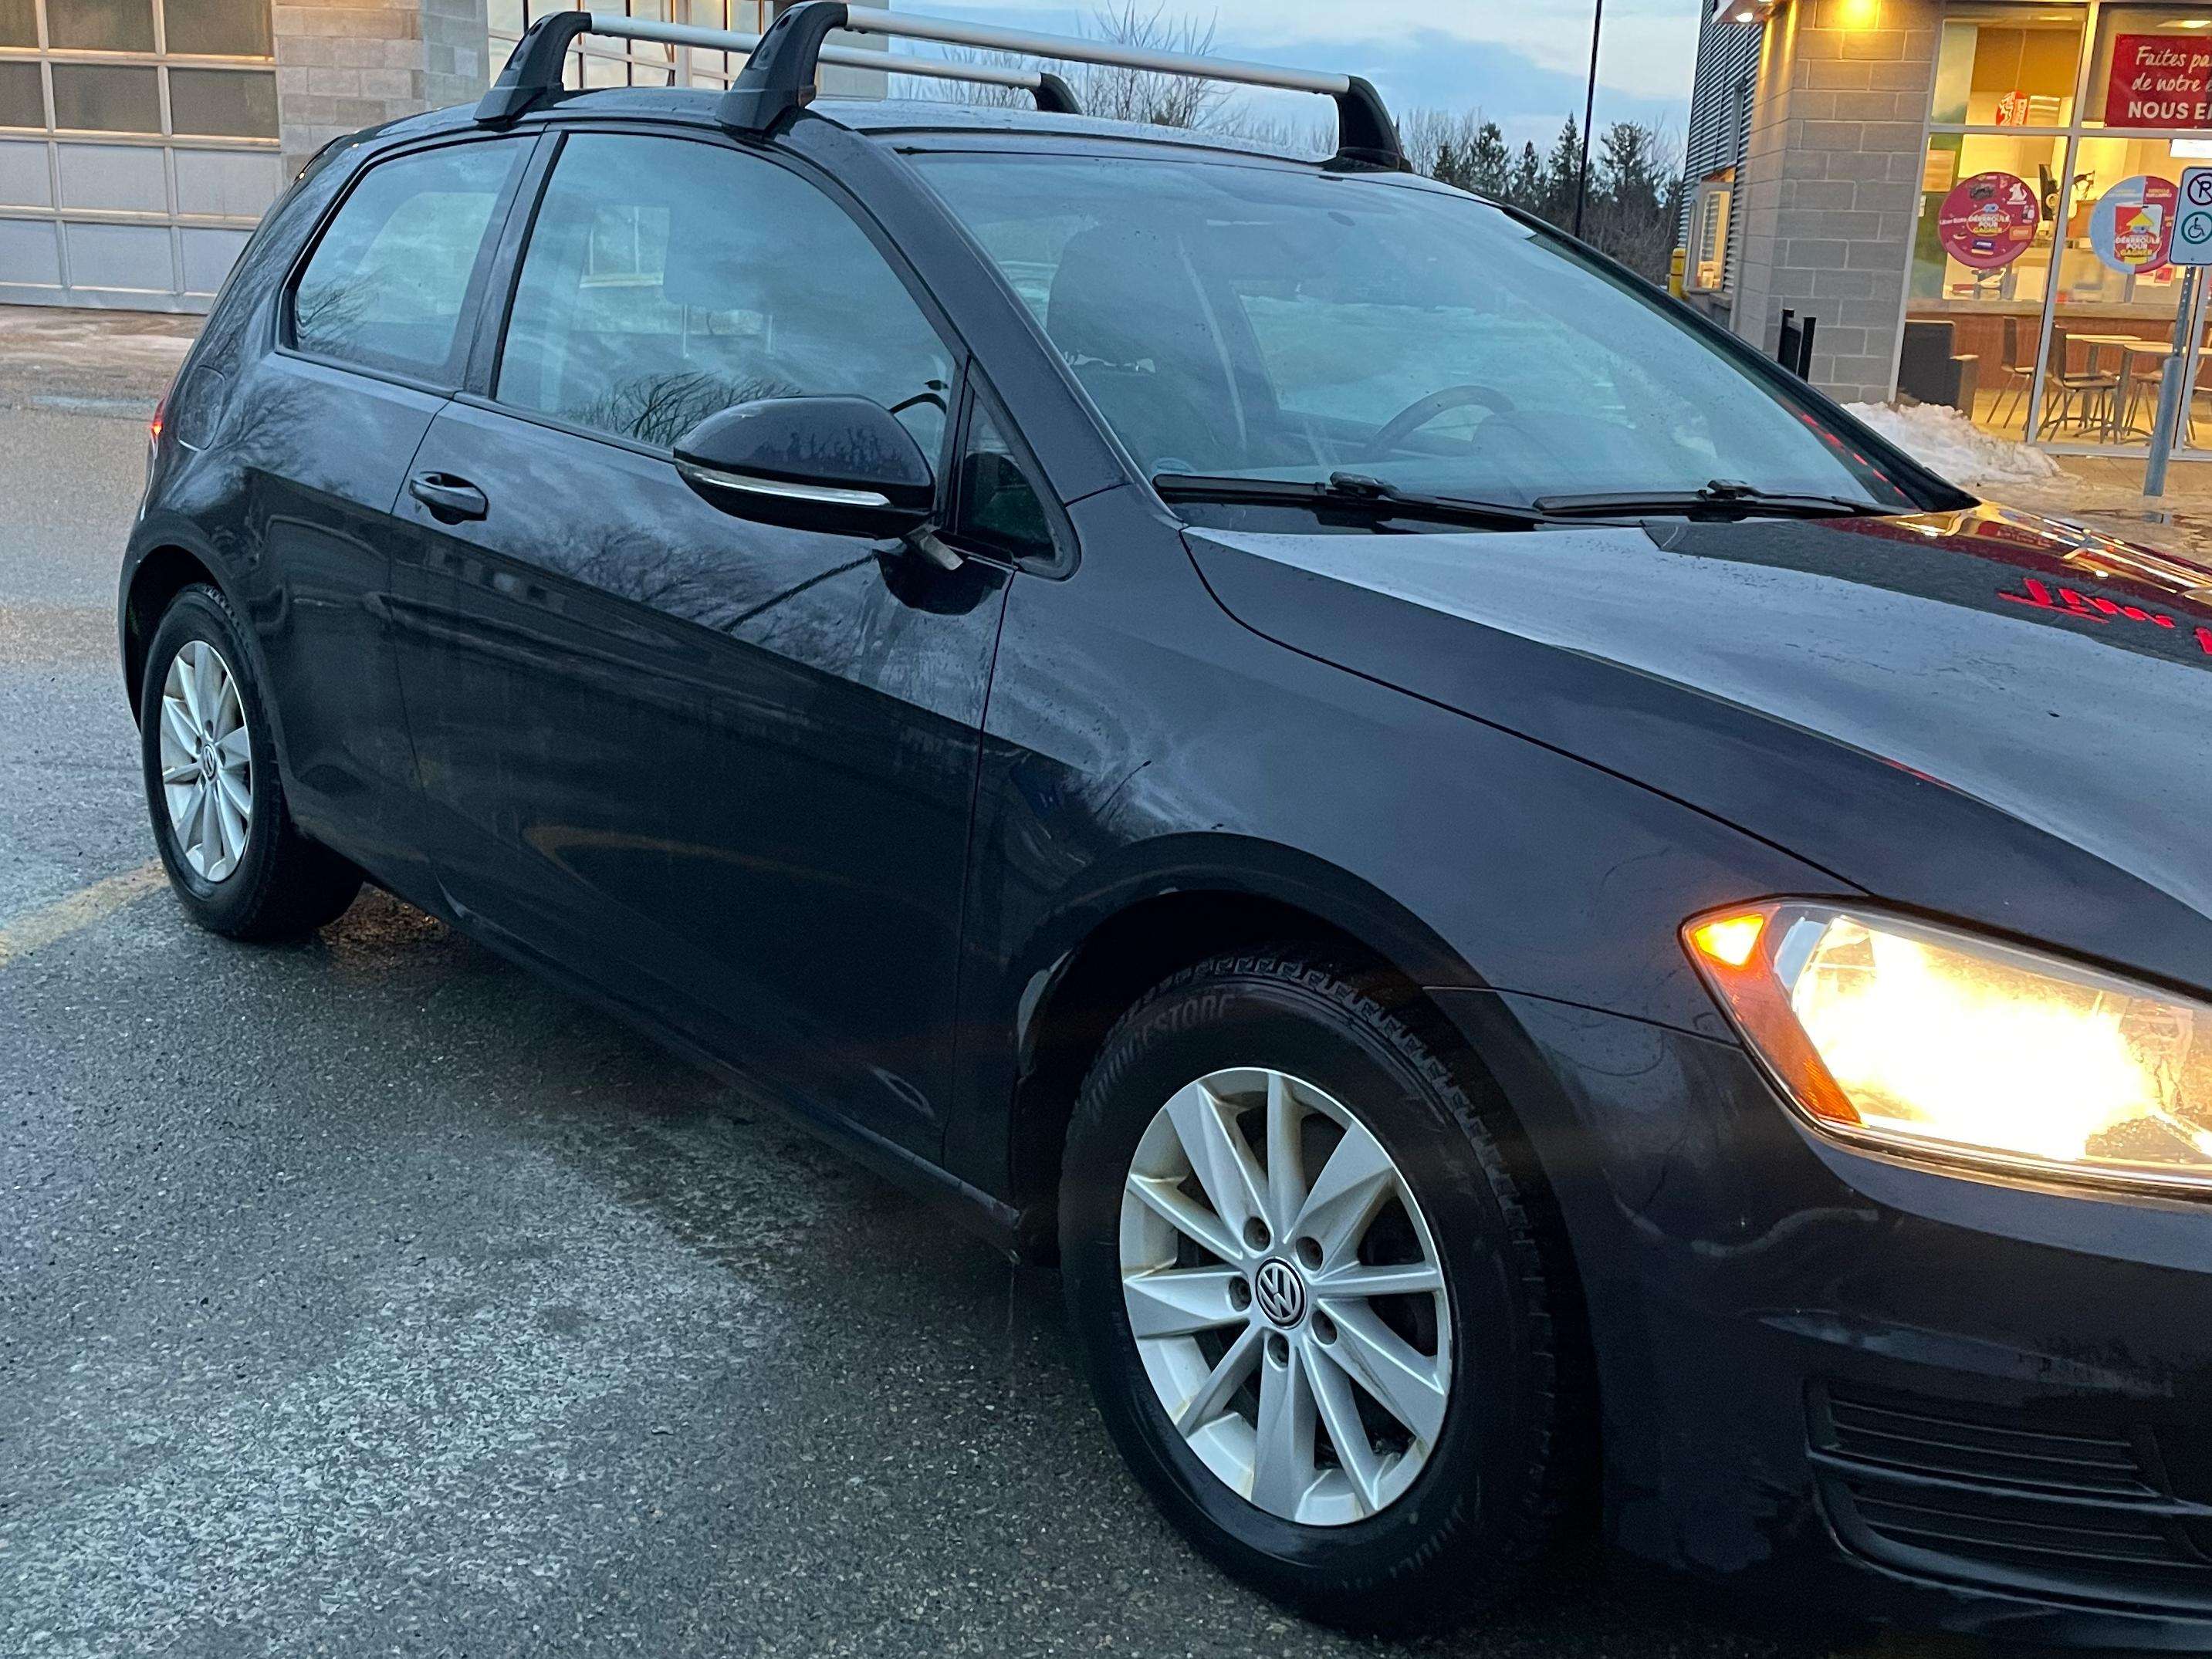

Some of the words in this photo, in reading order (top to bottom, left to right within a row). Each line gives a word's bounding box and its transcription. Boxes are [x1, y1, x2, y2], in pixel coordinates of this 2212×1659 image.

[2136, 46, 2187, 67] Faites
[2132, 72, 2153, 91] de
[2156, 74, 2201, 92] notre
[2128, 101, 2189, 120] NOUS
